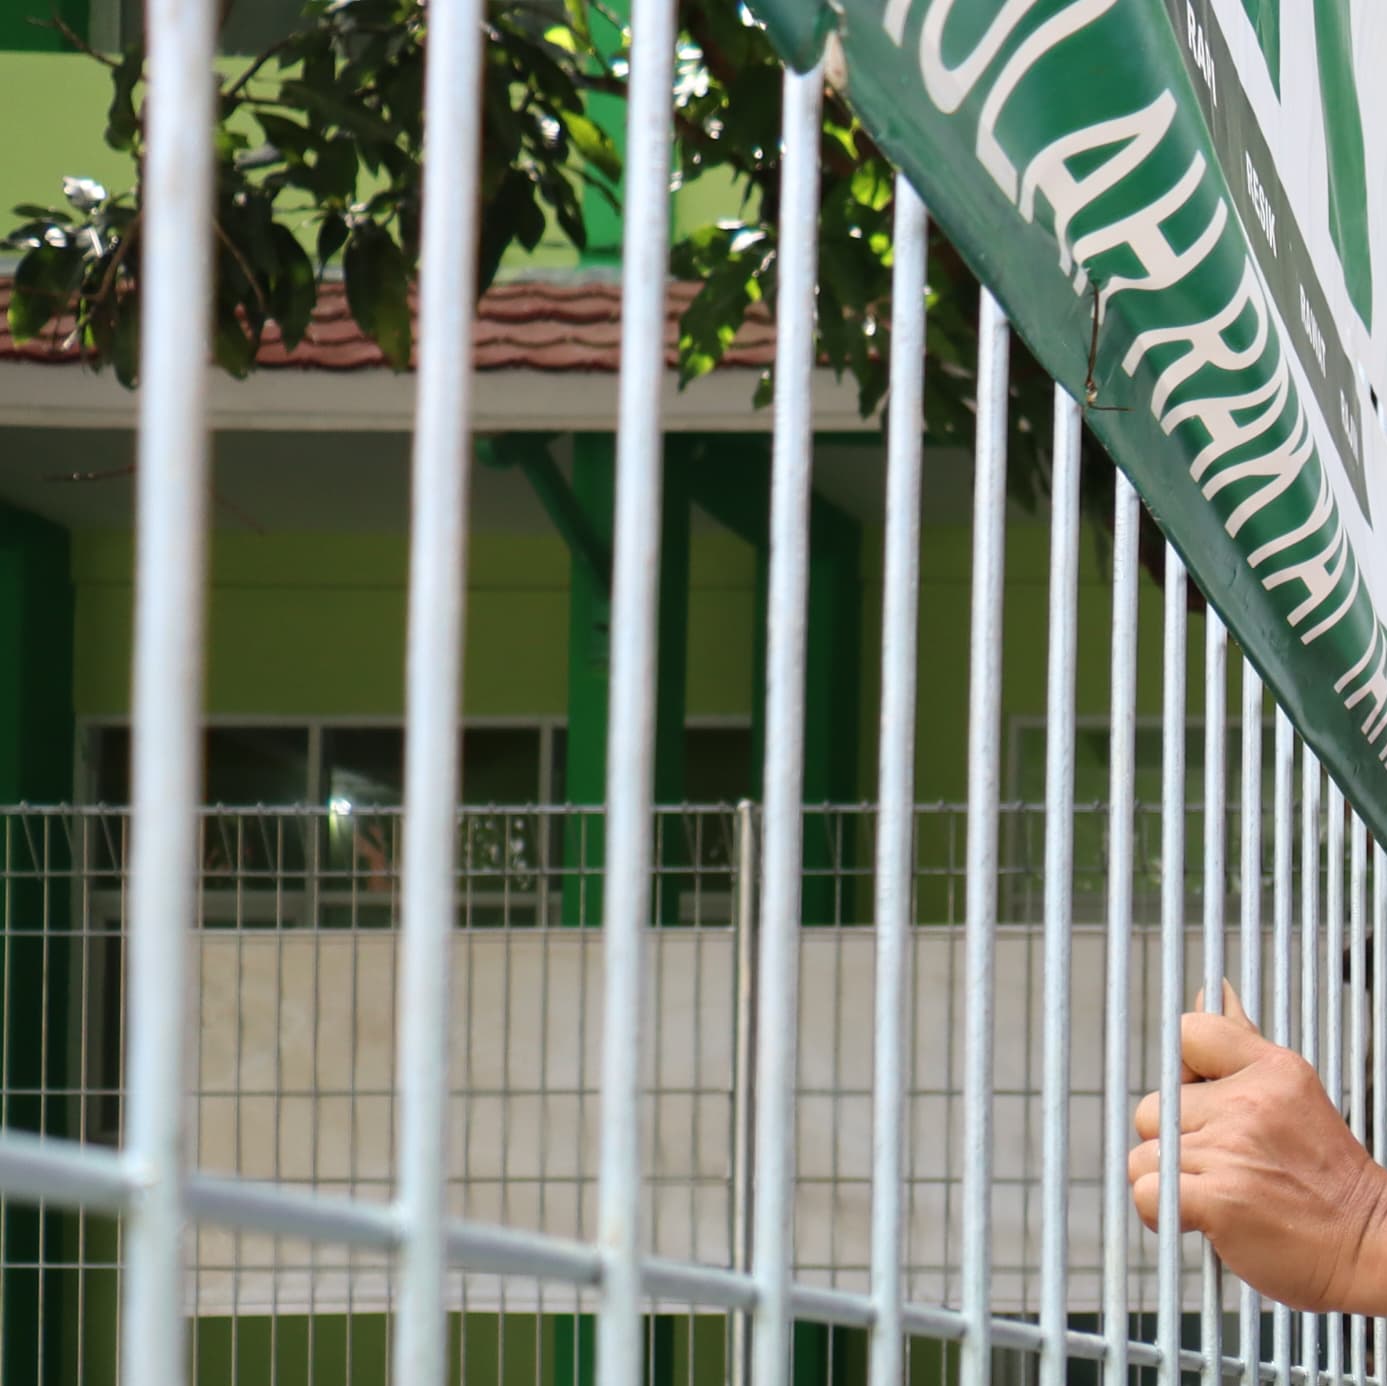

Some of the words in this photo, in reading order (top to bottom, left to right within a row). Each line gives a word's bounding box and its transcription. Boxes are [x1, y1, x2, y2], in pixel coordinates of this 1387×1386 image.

[882, 0, 1229, 327] OLAH
[1187, 0, 1217, 108] RAPI
[1245, 150, 1278, 259] RESIK
